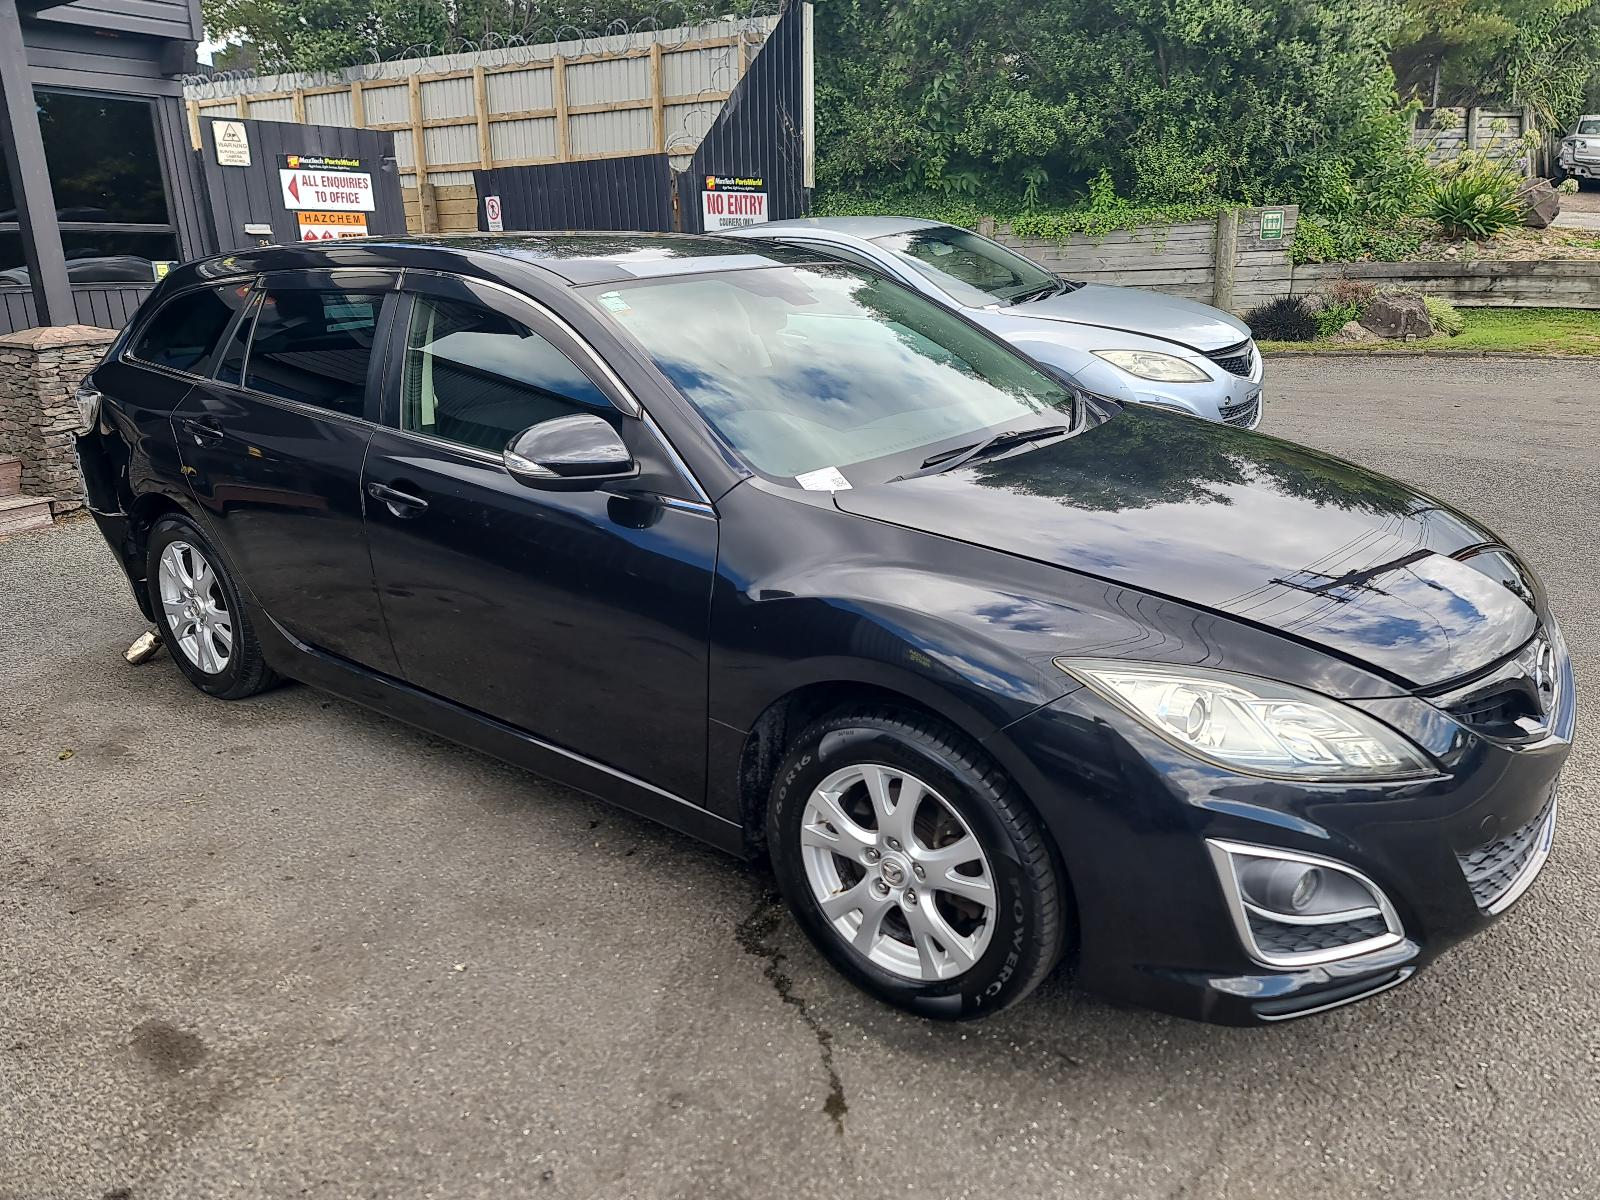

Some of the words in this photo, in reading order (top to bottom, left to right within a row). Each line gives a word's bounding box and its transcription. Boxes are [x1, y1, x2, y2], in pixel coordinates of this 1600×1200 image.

[324, 157, 360, 167] PartsWorld
[302, 174, 319, 187] ALL
[321, 175, 369, 190] ENQUIRIES
[315, 191, 327, 203] TO
[329, 191, 360, 204] OFFICE
[706, 193, 724, 215] NO
[727, 194, 764, 216] ENTRY
[304, 213, 361, 224] HAZCHEM
